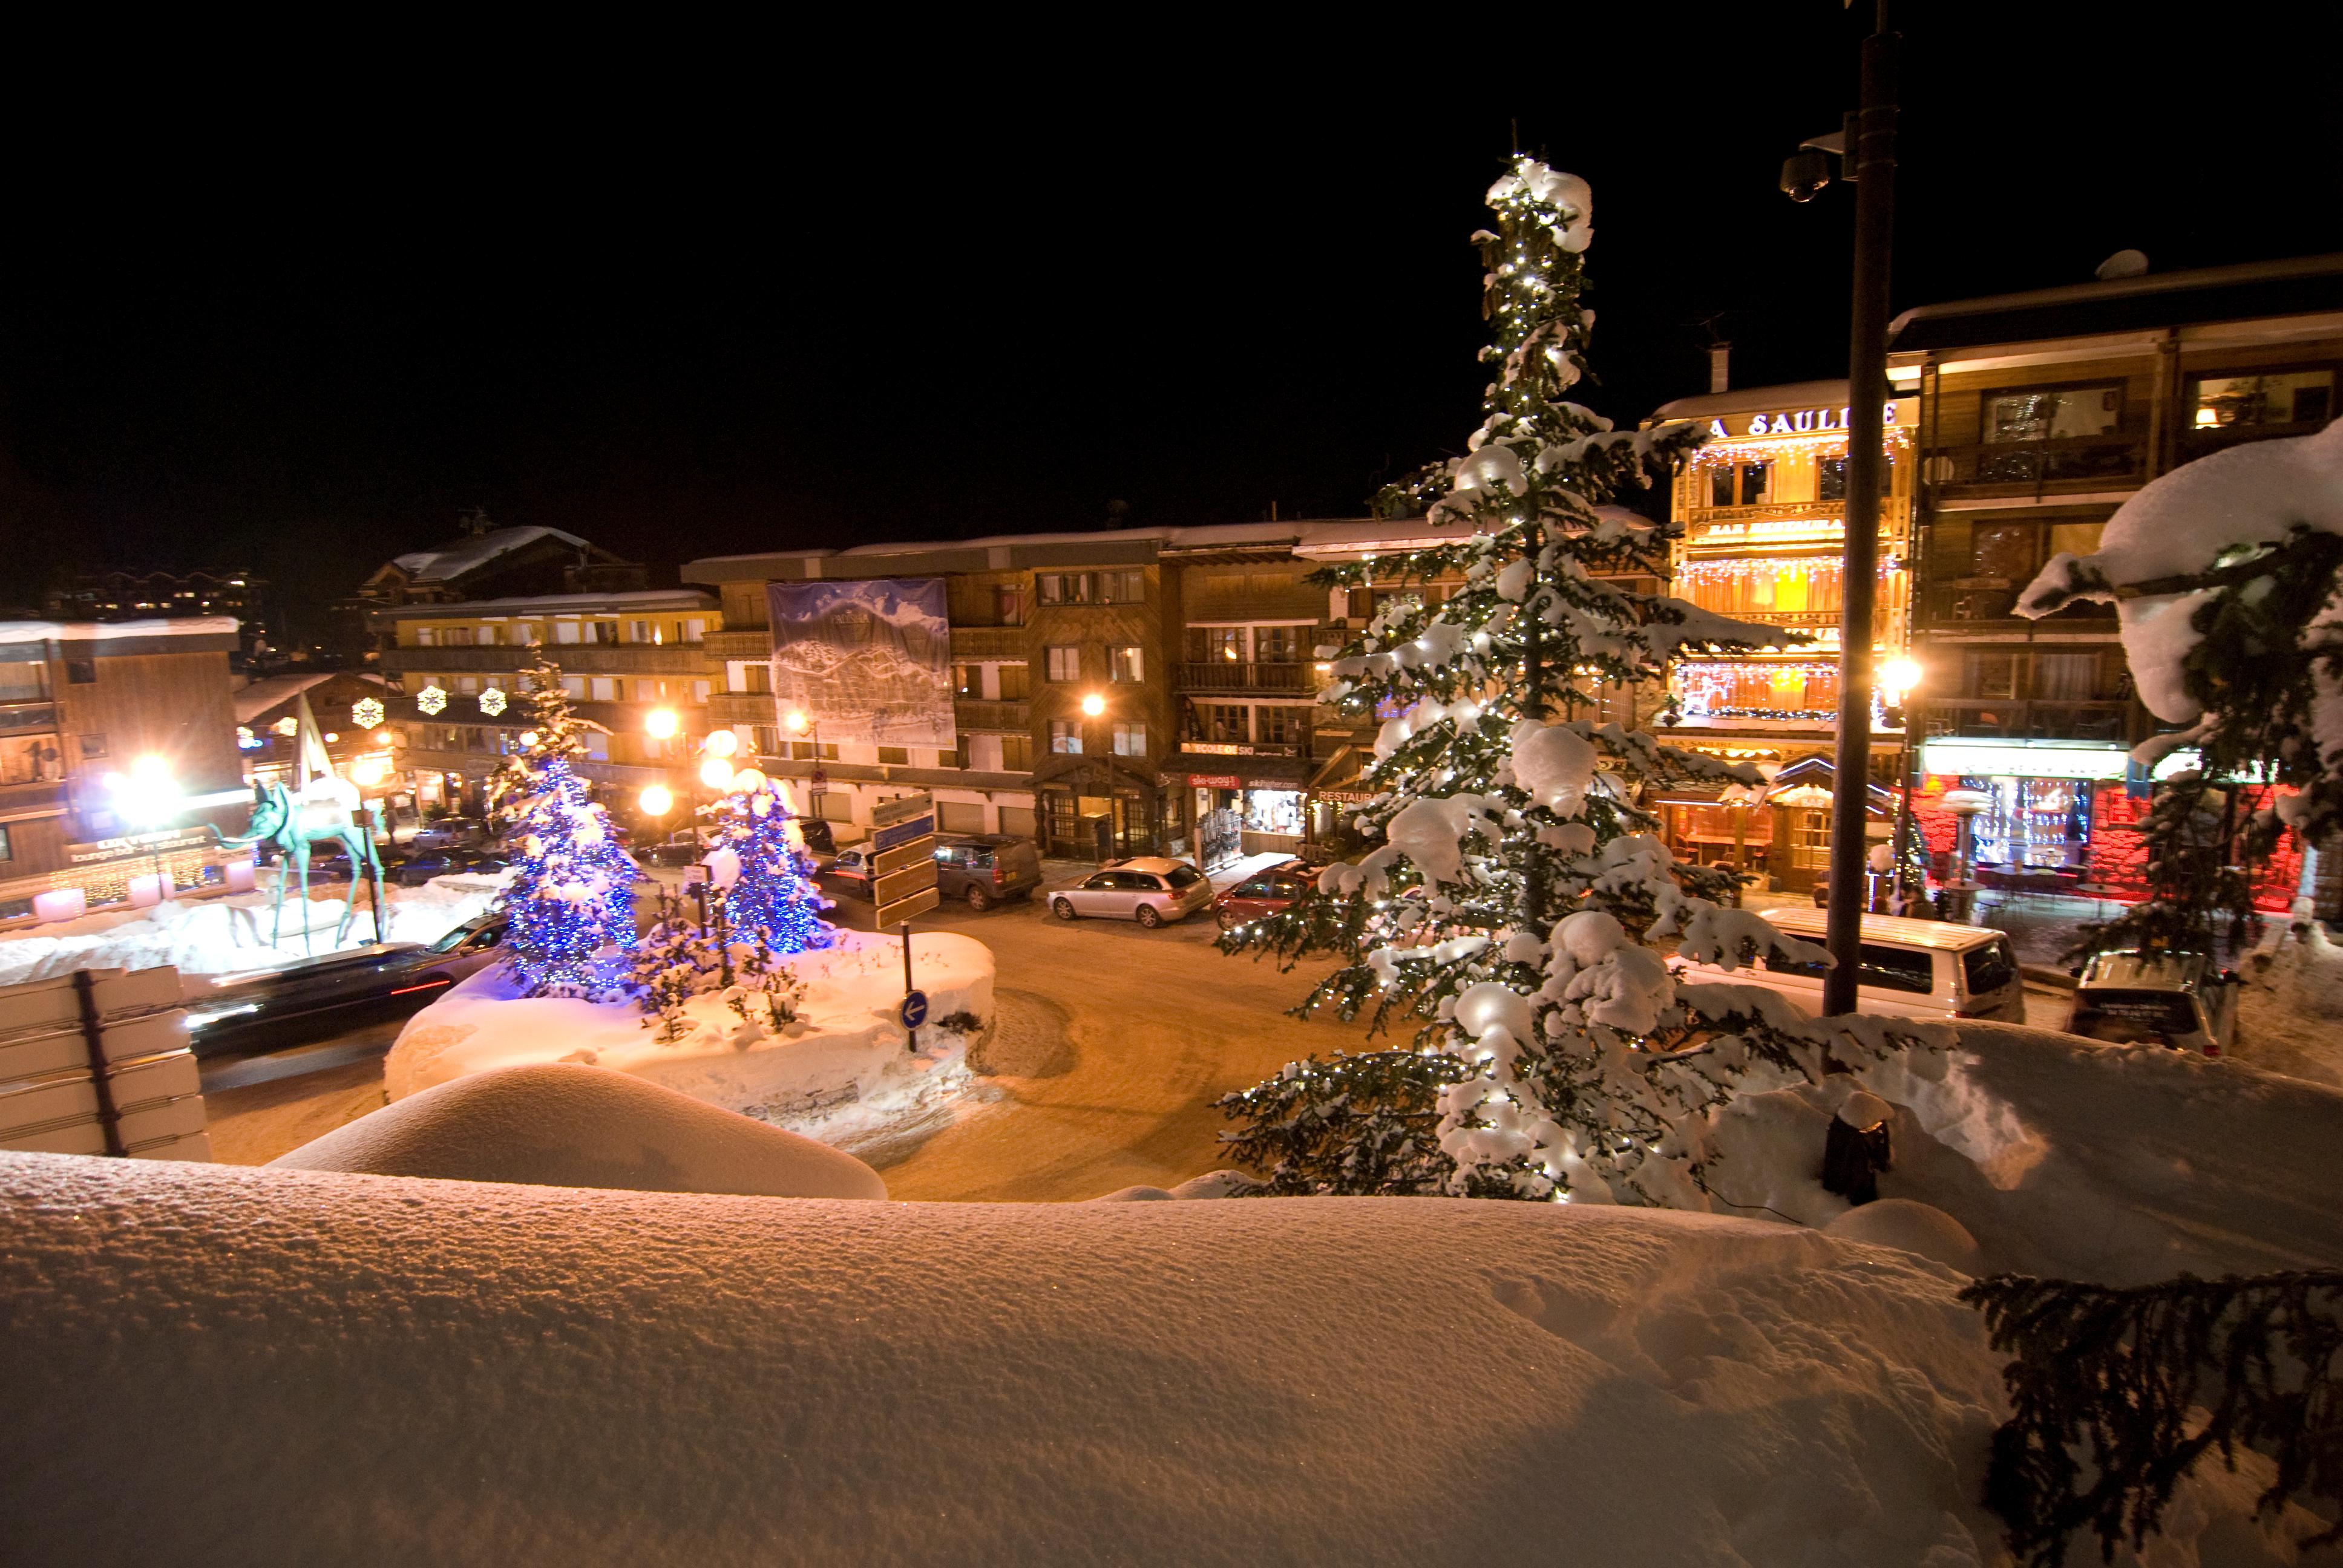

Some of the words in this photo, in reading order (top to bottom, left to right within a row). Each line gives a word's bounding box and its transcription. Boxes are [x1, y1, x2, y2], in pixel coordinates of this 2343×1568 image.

[1709, 418, 1729, 438] A
[1748, 402, 1897, 436] SAULIE
[1708, 523, 1745, 535] BAR
[1747, 518, 1844, 534] RESTAURA
[1239, 746, 1254, 756] SKI
[1319, 791, 1378, 803] RESTAUR
[1801, 798, 1826, 809] BAR
[71, 849, 114, 863] lounge
